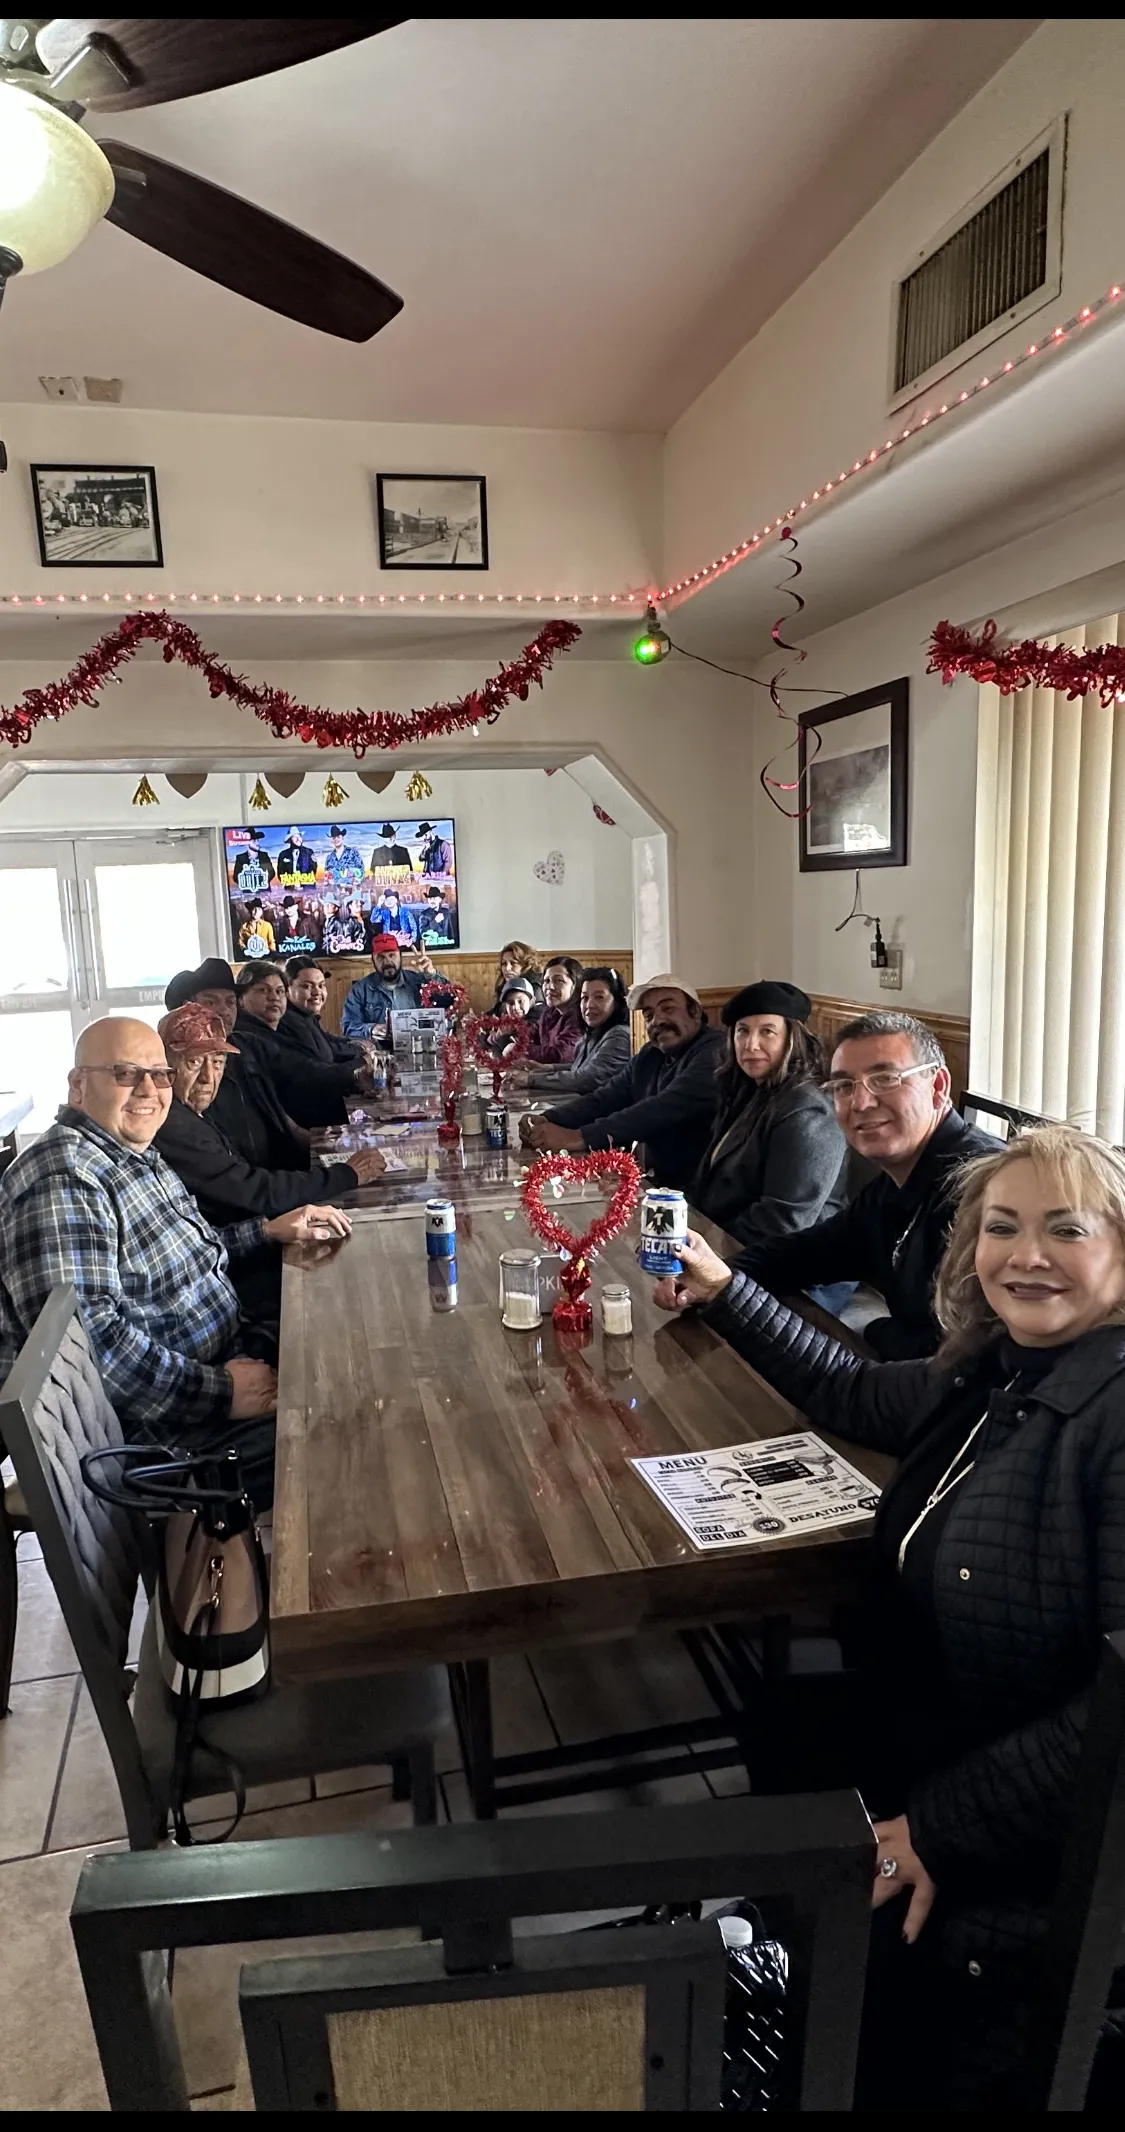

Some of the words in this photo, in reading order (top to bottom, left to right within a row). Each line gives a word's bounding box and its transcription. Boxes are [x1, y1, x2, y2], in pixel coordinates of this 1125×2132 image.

[658, 1457, 707, 1469] MENU
[788, 1503, 857, 1523] DESAYUNO
[694, 1525, 724, 1533] SOPA
[759, 1521, 779, 1529] $30
[701, 1533, 723, 1541] DEL
[726, 1531, 746, 1539] DIA
